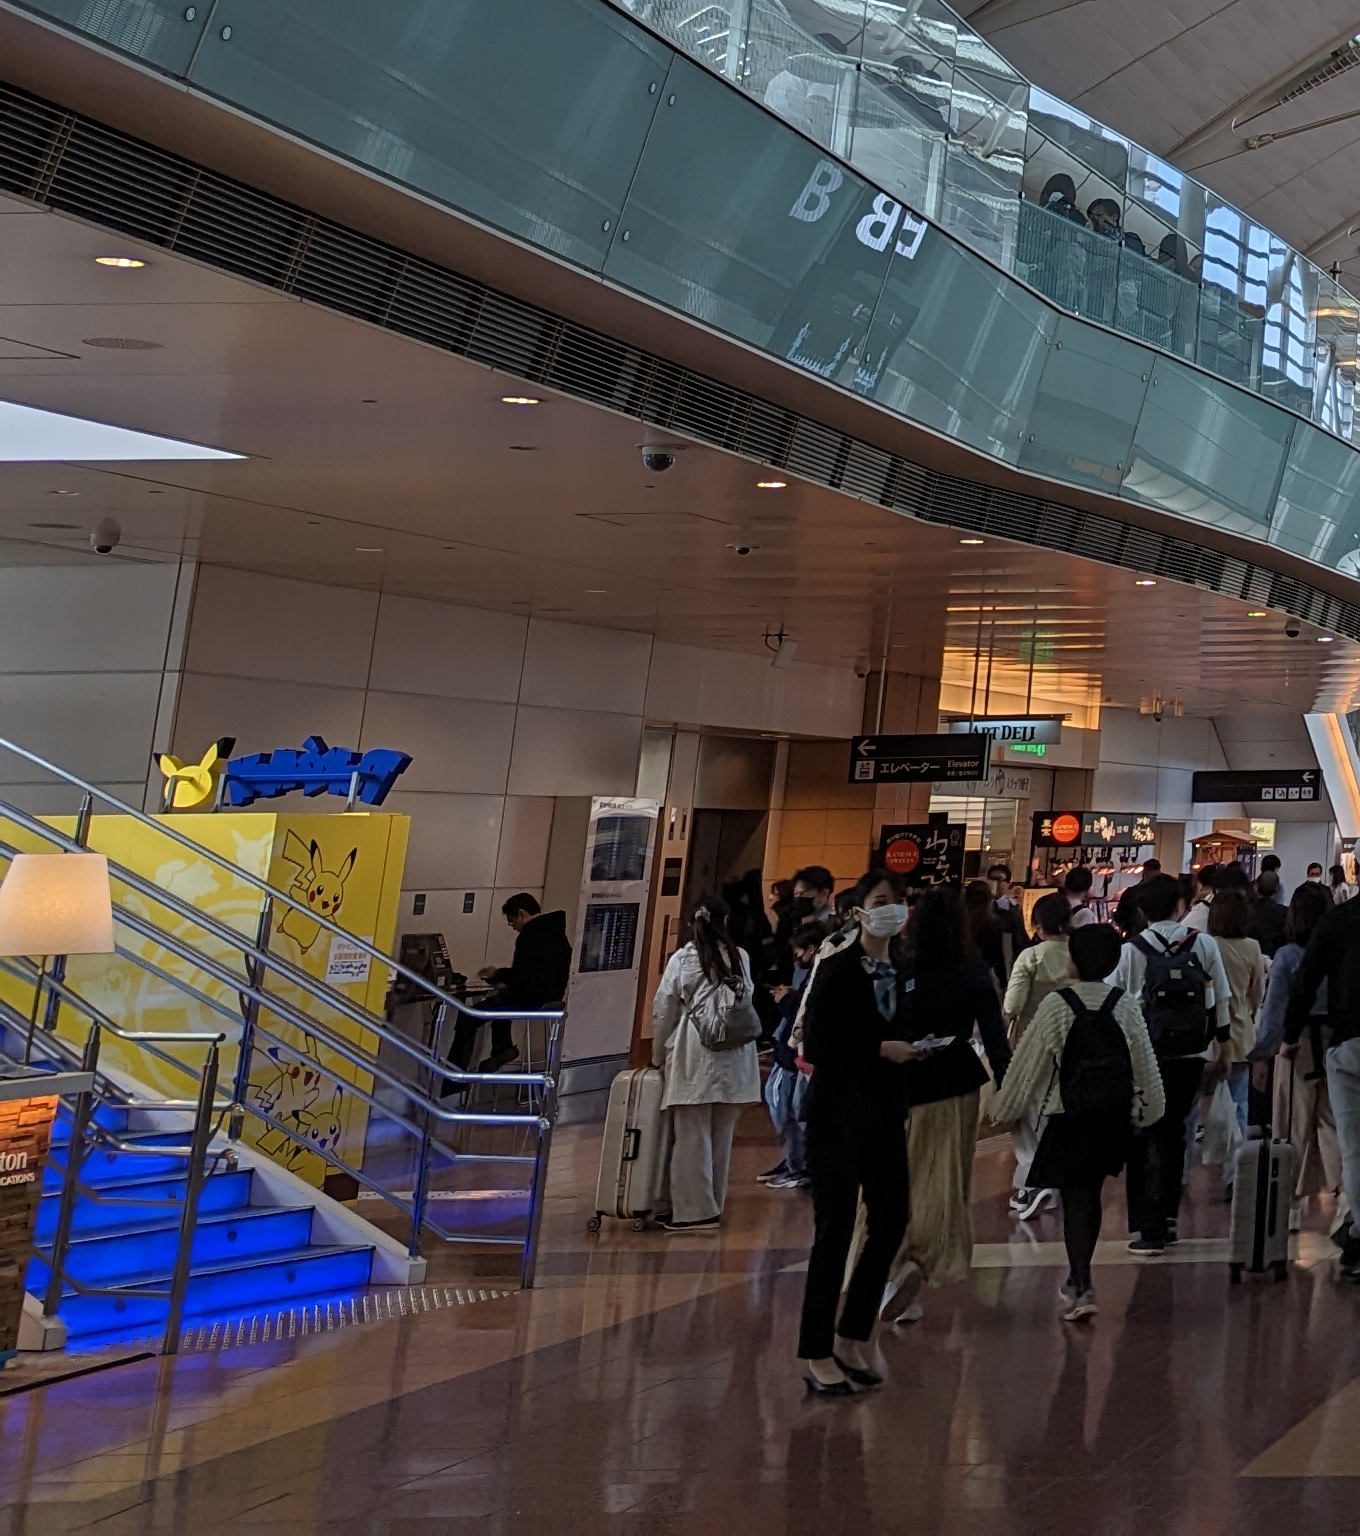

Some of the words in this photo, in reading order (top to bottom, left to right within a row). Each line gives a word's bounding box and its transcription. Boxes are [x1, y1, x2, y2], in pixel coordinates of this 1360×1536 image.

[880, 762, 940, 774] エレベーター
[947, 760, 979, 768] Elevator
